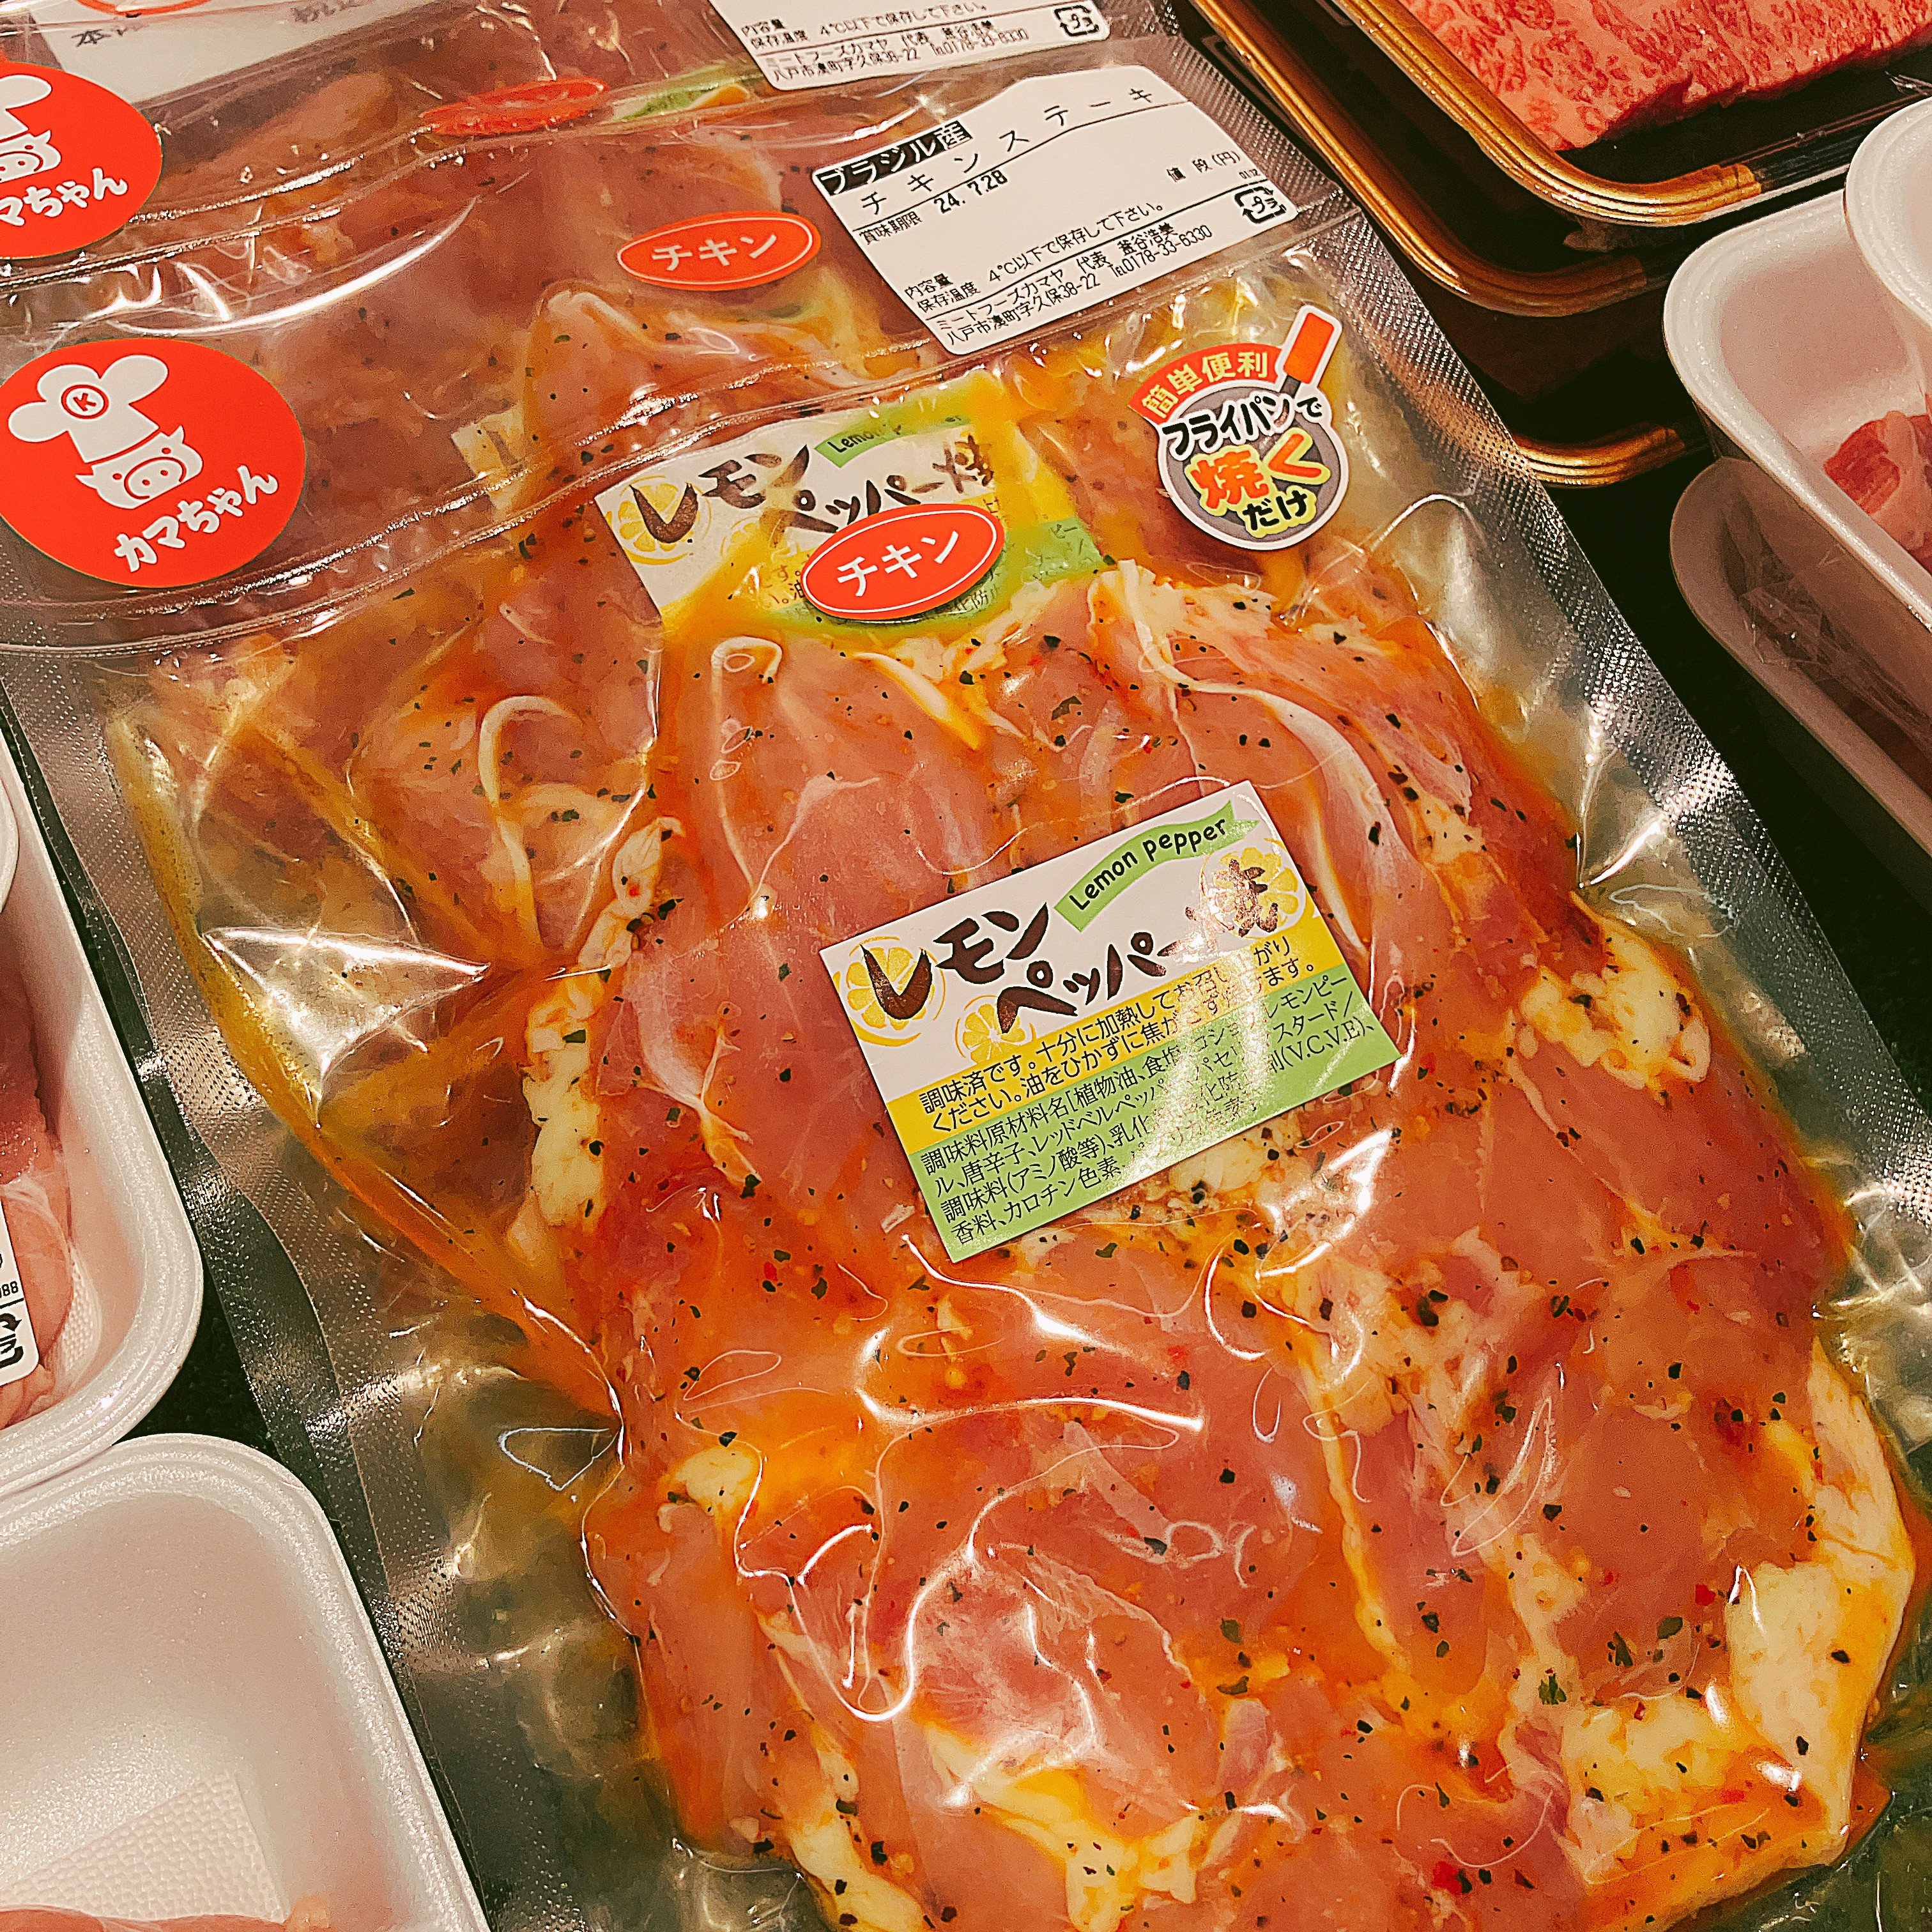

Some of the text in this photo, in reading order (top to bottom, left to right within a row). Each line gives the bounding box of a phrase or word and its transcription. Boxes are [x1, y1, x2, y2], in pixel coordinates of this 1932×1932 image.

[820, 120, 972, 194] ブラジル産
[651, 233, 778, 272] チキン
[859, 211, 923, 245] 賞味期限
[904, 272, 954, 300] 内容量
[1076, 250, 1111, 274] 代表
[917, 281, 981, 313] 保存温度
[1141, 351, 1269, 419] 簡単便利
[1162, 395, 1322, 456] フライパンで
[629, 444, 809, 543] レモン
[1190, 433, 1322, 509] 焼く
[114, 464, 279, 572] カマちゃん
[1242, 490, 1308, 531] だけ
[837, 530, 959, 597] チキン
[1069, 817, 1227, 911] Lemon pepper
[860, 901, 1049, 1020] レモン
